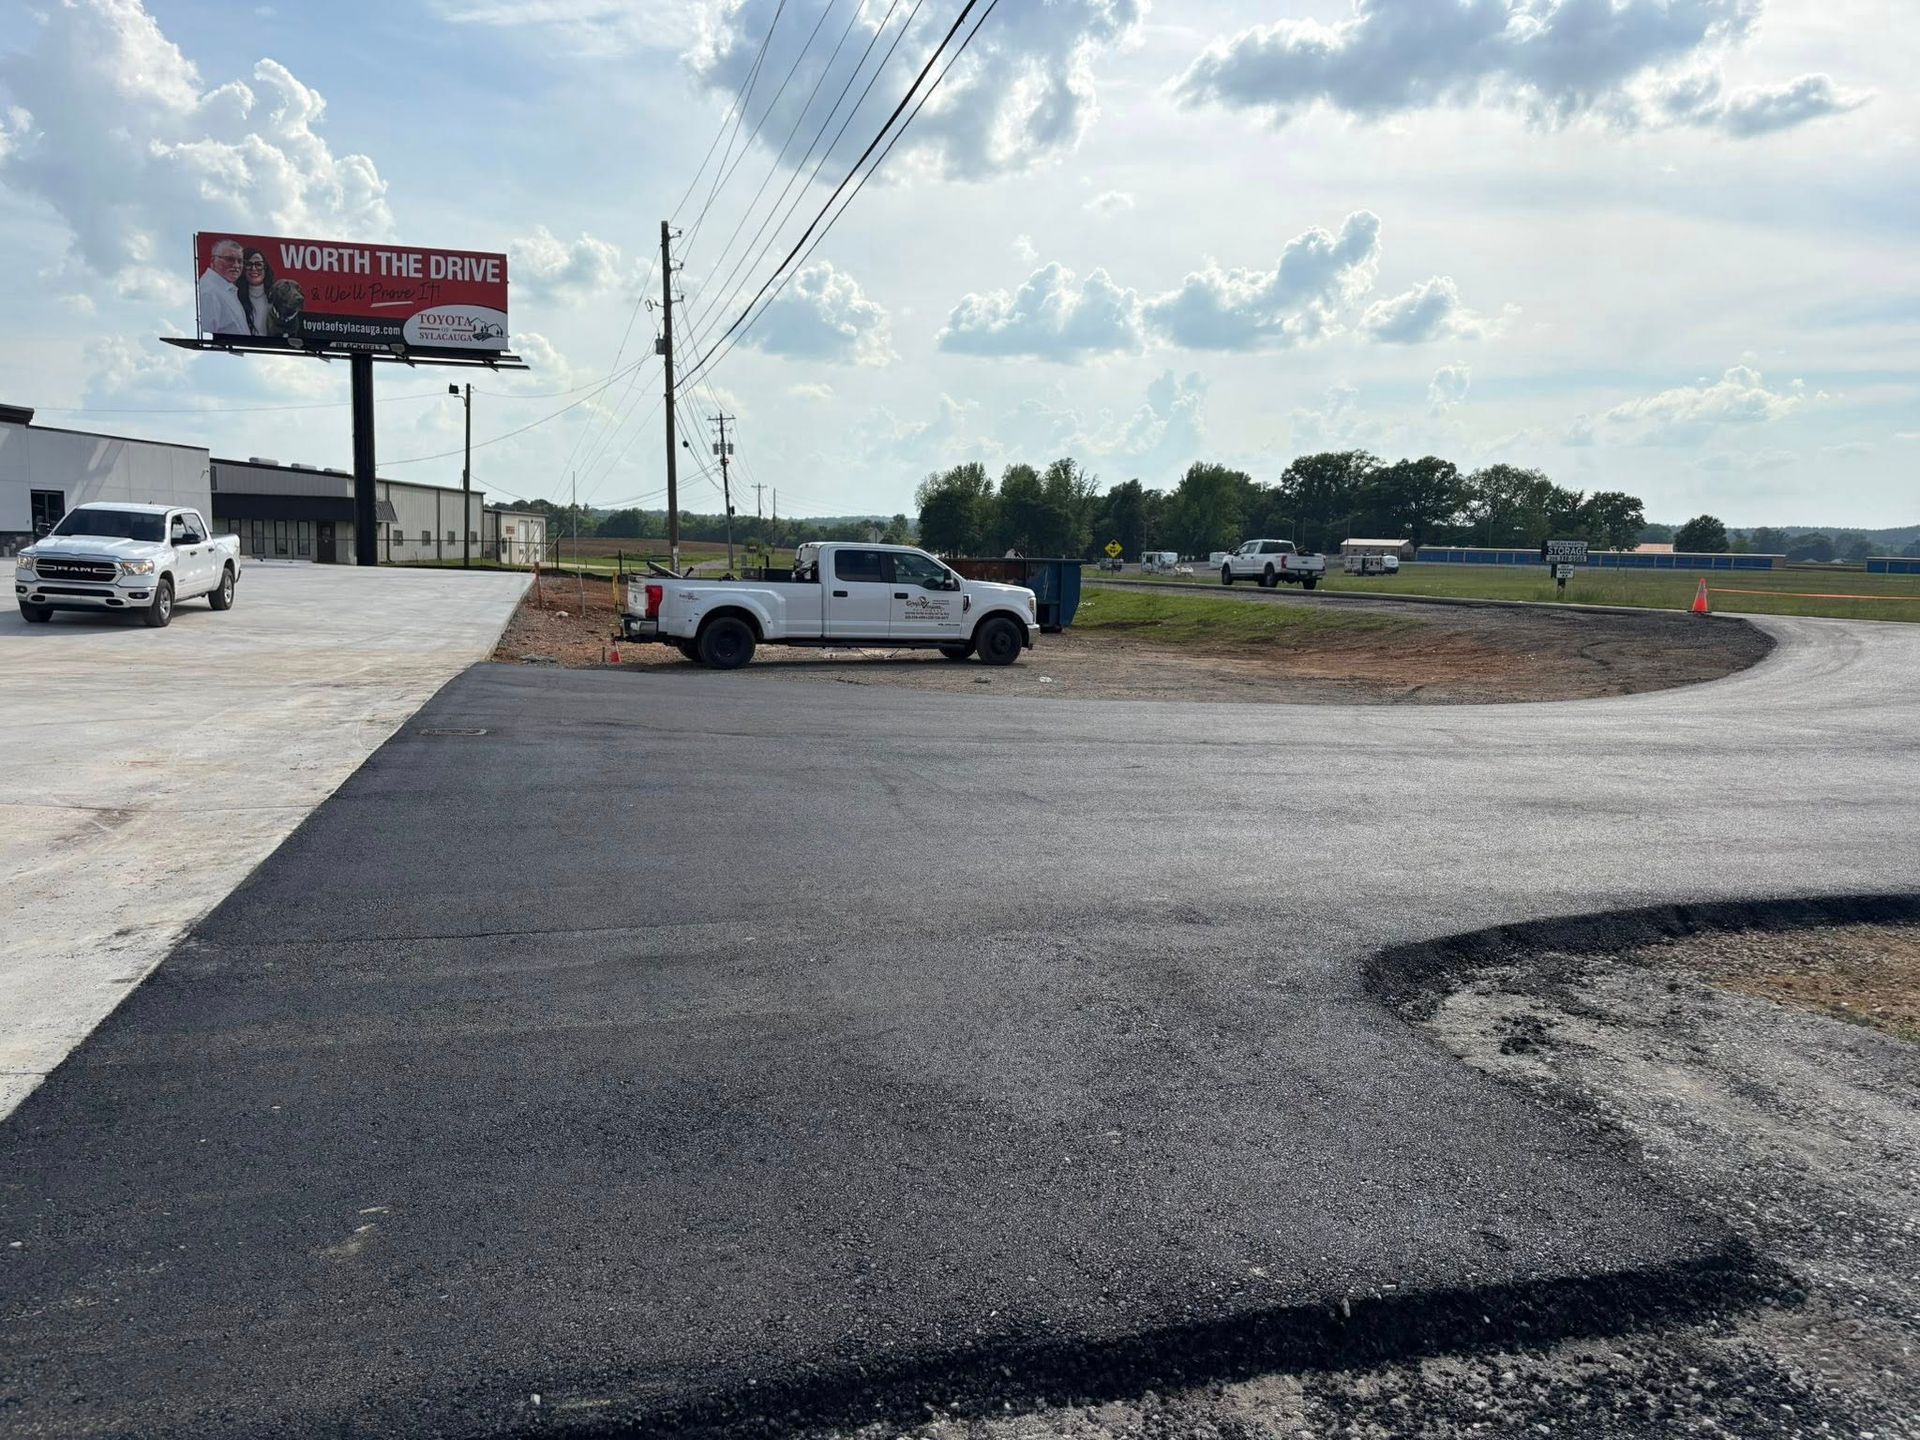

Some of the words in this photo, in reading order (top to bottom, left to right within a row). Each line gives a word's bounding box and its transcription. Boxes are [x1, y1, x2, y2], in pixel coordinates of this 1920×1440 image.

[280, 244, 370, 275] WORTH
[376, 251, 423, 279] THE
[430, 255, 500, 283] DRIVE
[311, 288, 321, 301] &
[369, 283, 416, 301] Prove
[303, 319, 400, 337] toyotaofsylacauga.com
[418, 313, 473, 328] TOYOTA
[418, 332, 474, 342] SYLACAUGA
[1547, 547, 1587, 555] STORAGE
